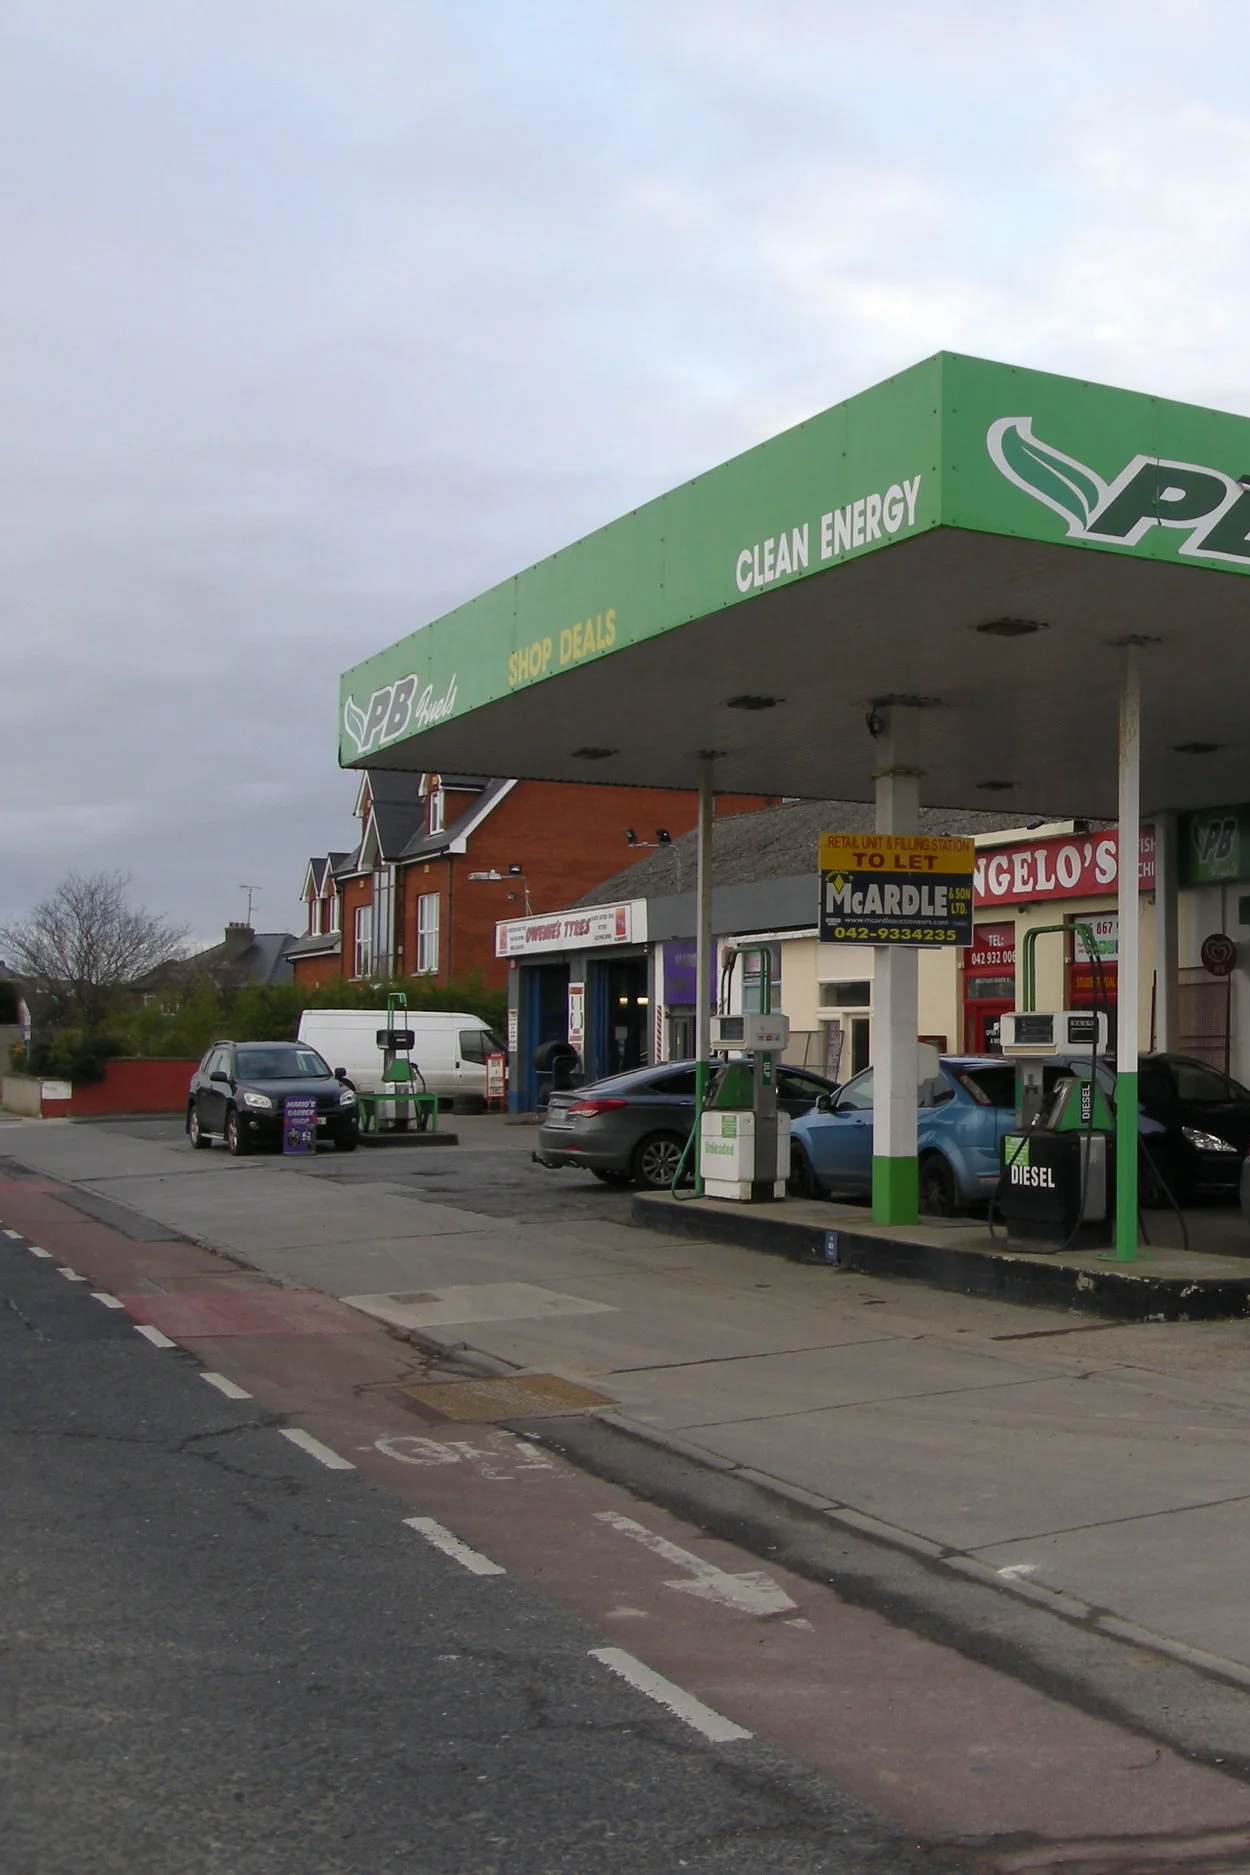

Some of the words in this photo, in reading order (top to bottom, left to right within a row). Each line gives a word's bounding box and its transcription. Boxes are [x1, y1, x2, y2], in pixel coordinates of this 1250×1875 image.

[736, 522, 808, 592] CLEAN
[819, 475, 922, 561] ENERGY
[508, 636, 552, 687] SHOP
[559, 608, 616, 664] DEALS
[361, 673, 418, 752] PB
[414, 673, 457, 730] Fuels
[828, 836, 858, 849] RETAIL
[862, 836, 883, 849] UNIT
[886, 838, 892, 849] &
[895, 838, 930, 852] FILLING
[931, 838, 970, 853] STATION
[1202, 818, 1237, 863] PB
[852, 853, 885, 868] TO
[894, 854, 938, 870] LET
[826, 882, 947, 917] McARDLE
[948, 888, 953, 899] &
[955, 887, 970, 900] SON
[564, 918, 591, 938] TYRES
[845, 917, 949, 926] www.mcardleauctioneers.com
[1096, 921, 1113, 935] 867
[834, 927, 956, 941] 042-9334235
[988, 934, 1004, 947] TEL:
[972, 953, 985, 965] 042
[987, 952, 1000, 963] 932
[1076, 976, 1101, 988] STUDET
[763, 1062, 771, 1077] ULP
[1082, 1085, 1090, 1119] DIESEL
[1011, 1165, 1055, 1188] DIESEL
